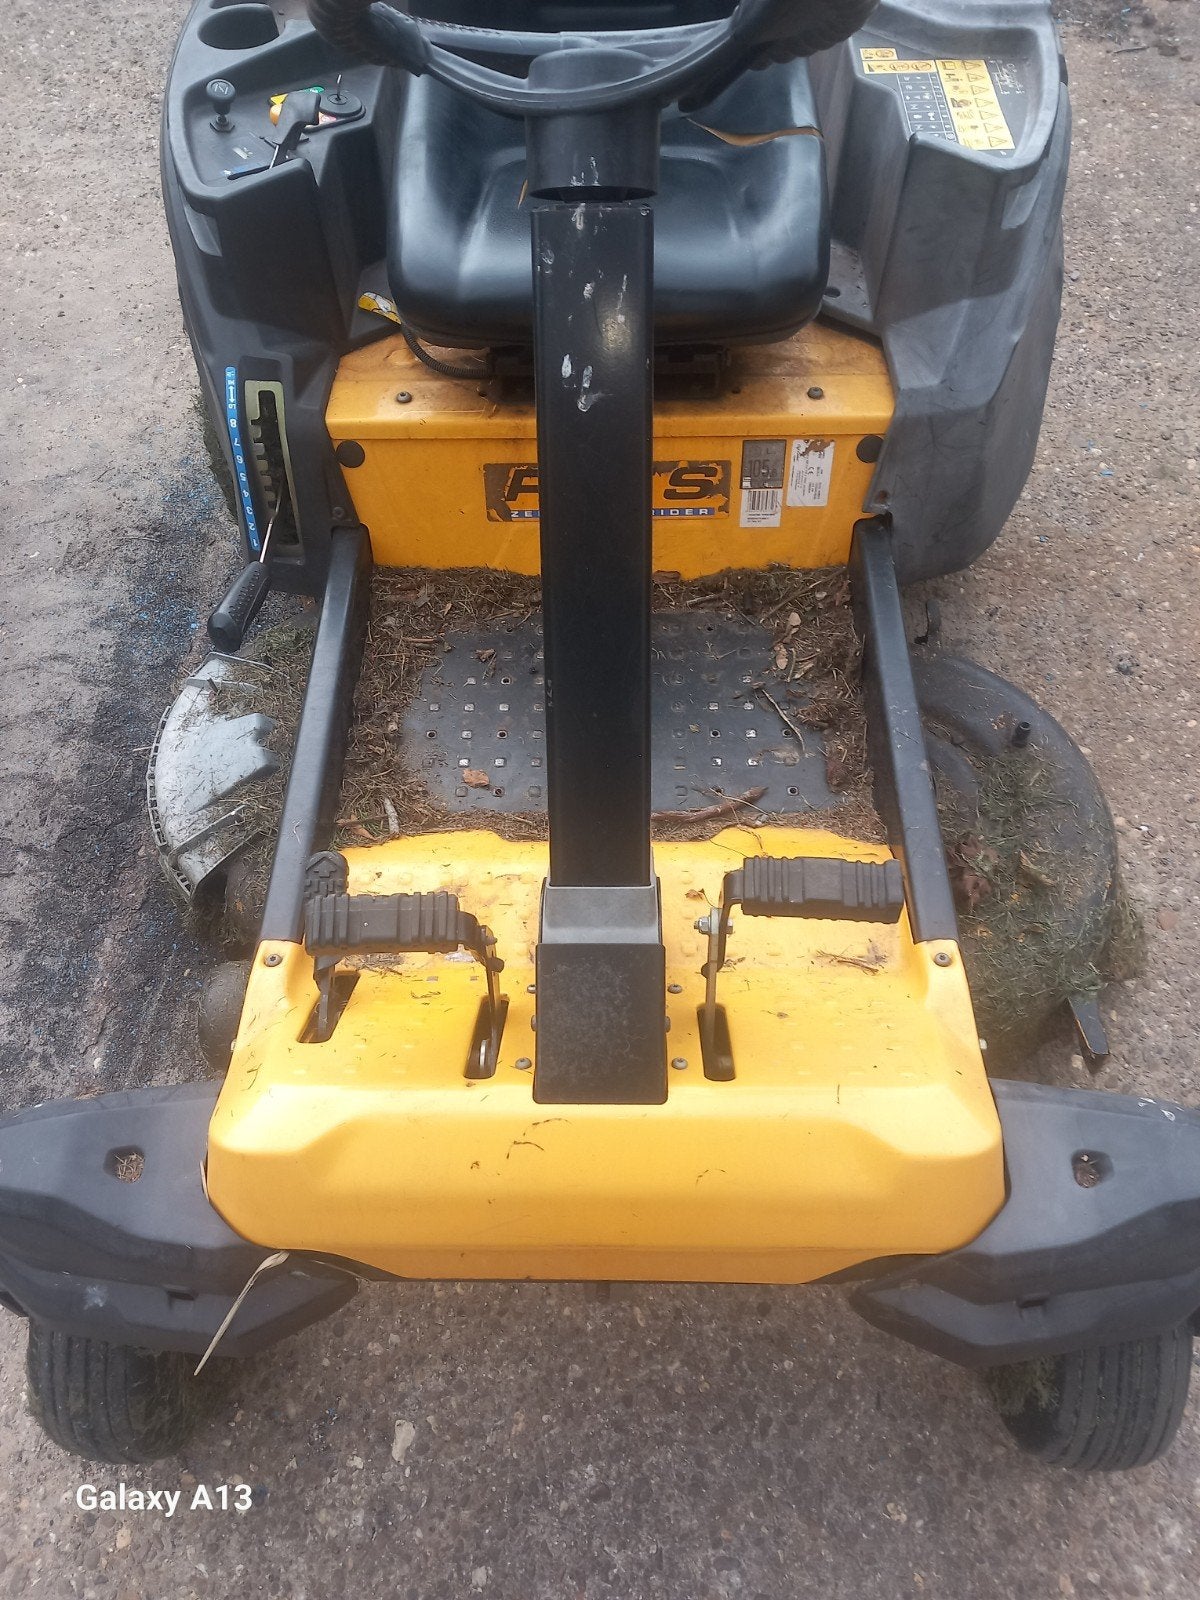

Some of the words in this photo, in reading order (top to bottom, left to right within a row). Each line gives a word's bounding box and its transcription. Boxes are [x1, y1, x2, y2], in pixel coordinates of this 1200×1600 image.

[230, 419, 237, 428] 8
[234, 438, 240, 447] 7
[237, 455, 244, 464] 6
[239, 473, 247, 482] 5
[242, 490, 249, 498] 4
[246, 506, 253, 515] 3
[652, 508, 709, 516] IDER
[248, 522, 255, 531] 2
